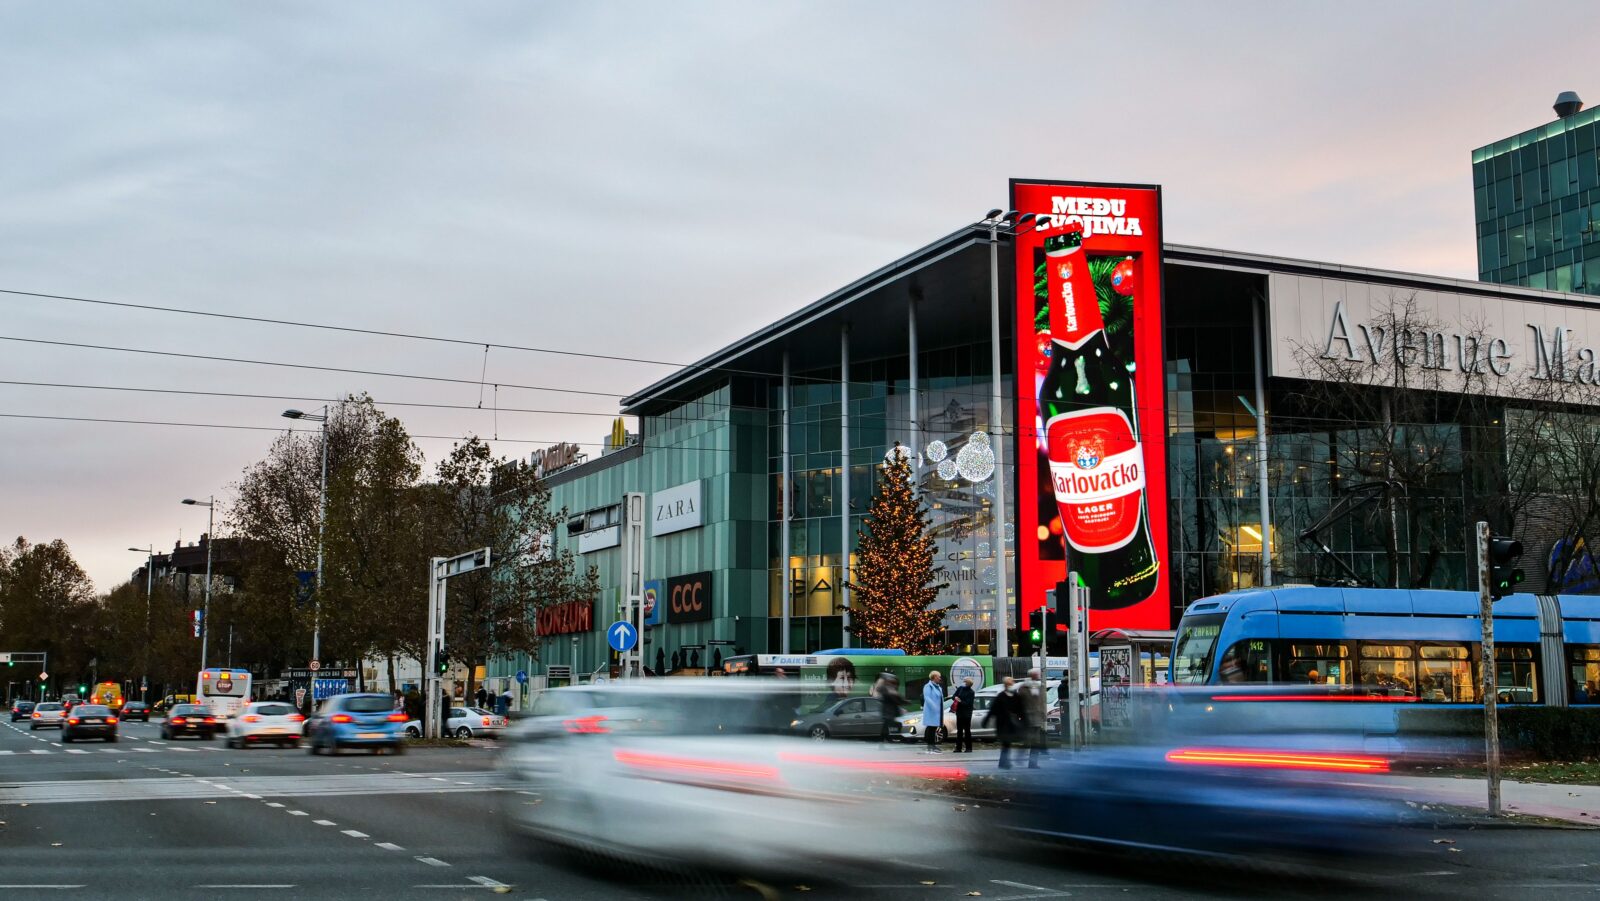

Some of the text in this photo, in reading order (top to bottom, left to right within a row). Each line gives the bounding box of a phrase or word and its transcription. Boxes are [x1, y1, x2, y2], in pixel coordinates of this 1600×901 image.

[1051, 196, 1127, 217] MEĐU
[1320, 300, 1513, 377] Avenue
[1051, 464, 1139, 495] Karlovačko
[656, 497, 696, 522] ZARA
[1077, 503, 1114, 515] LAGER
[672, 582, 703, 614] CCC
[536, 601, 590, 637] KONZUM
[1250, 641, 1264, 650] 1412
